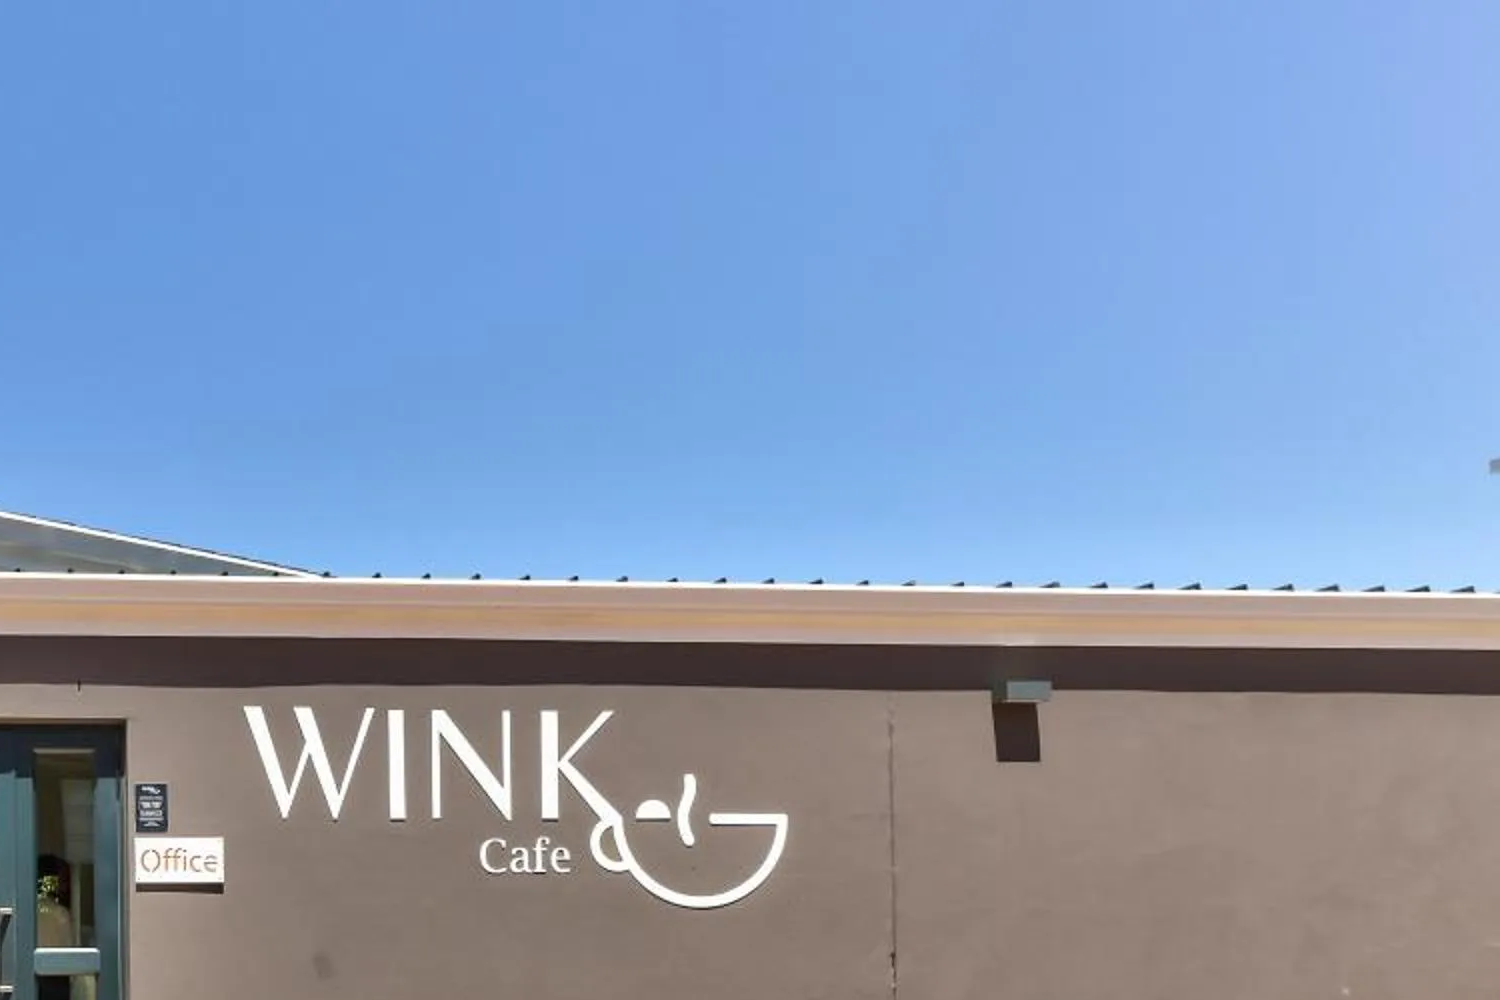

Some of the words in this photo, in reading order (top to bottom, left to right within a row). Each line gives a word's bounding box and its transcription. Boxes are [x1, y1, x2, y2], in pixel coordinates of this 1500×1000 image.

[243, 705, 622, 821] WINK
[140, 847, 219, 873] Office
[479, 836, 572, 874] Cafe
